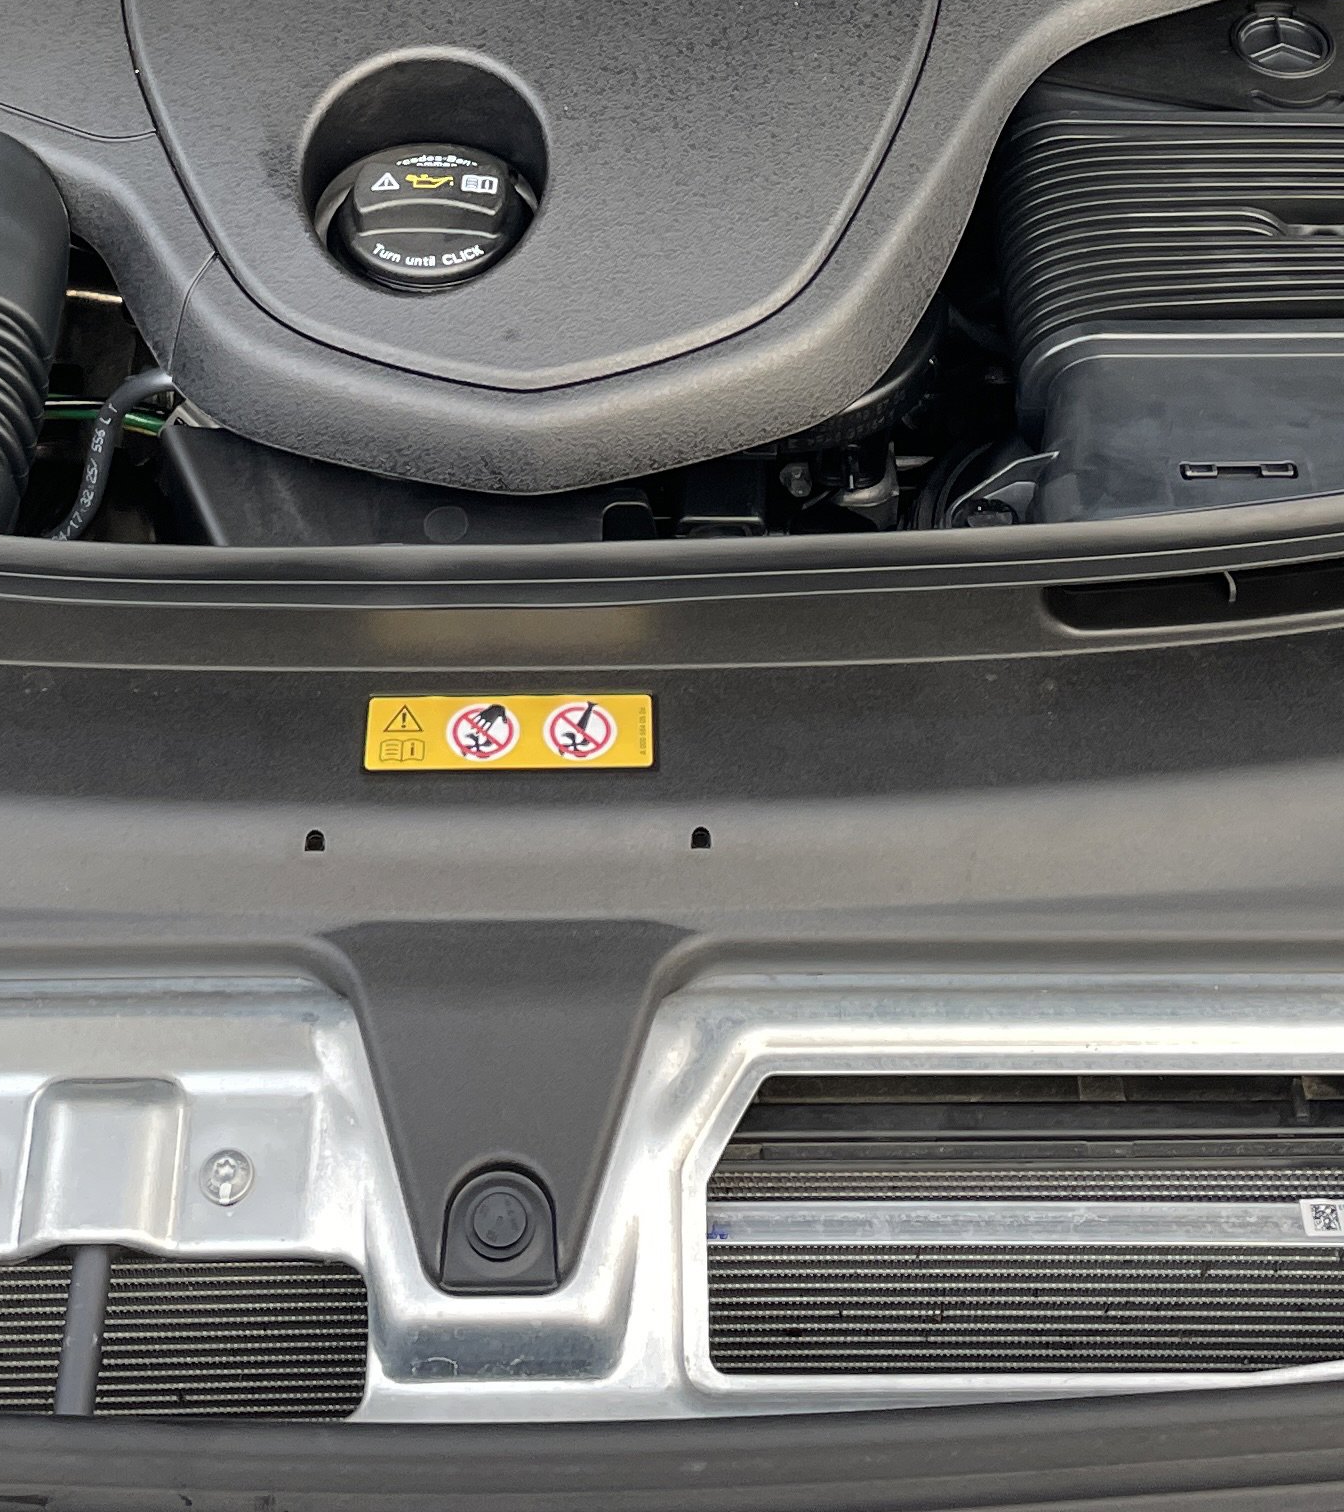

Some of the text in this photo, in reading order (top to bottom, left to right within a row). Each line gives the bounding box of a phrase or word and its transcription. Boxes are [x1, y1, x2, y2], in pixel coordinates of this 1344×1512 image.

[372, 243, 485, 267] Turn until CLICK
